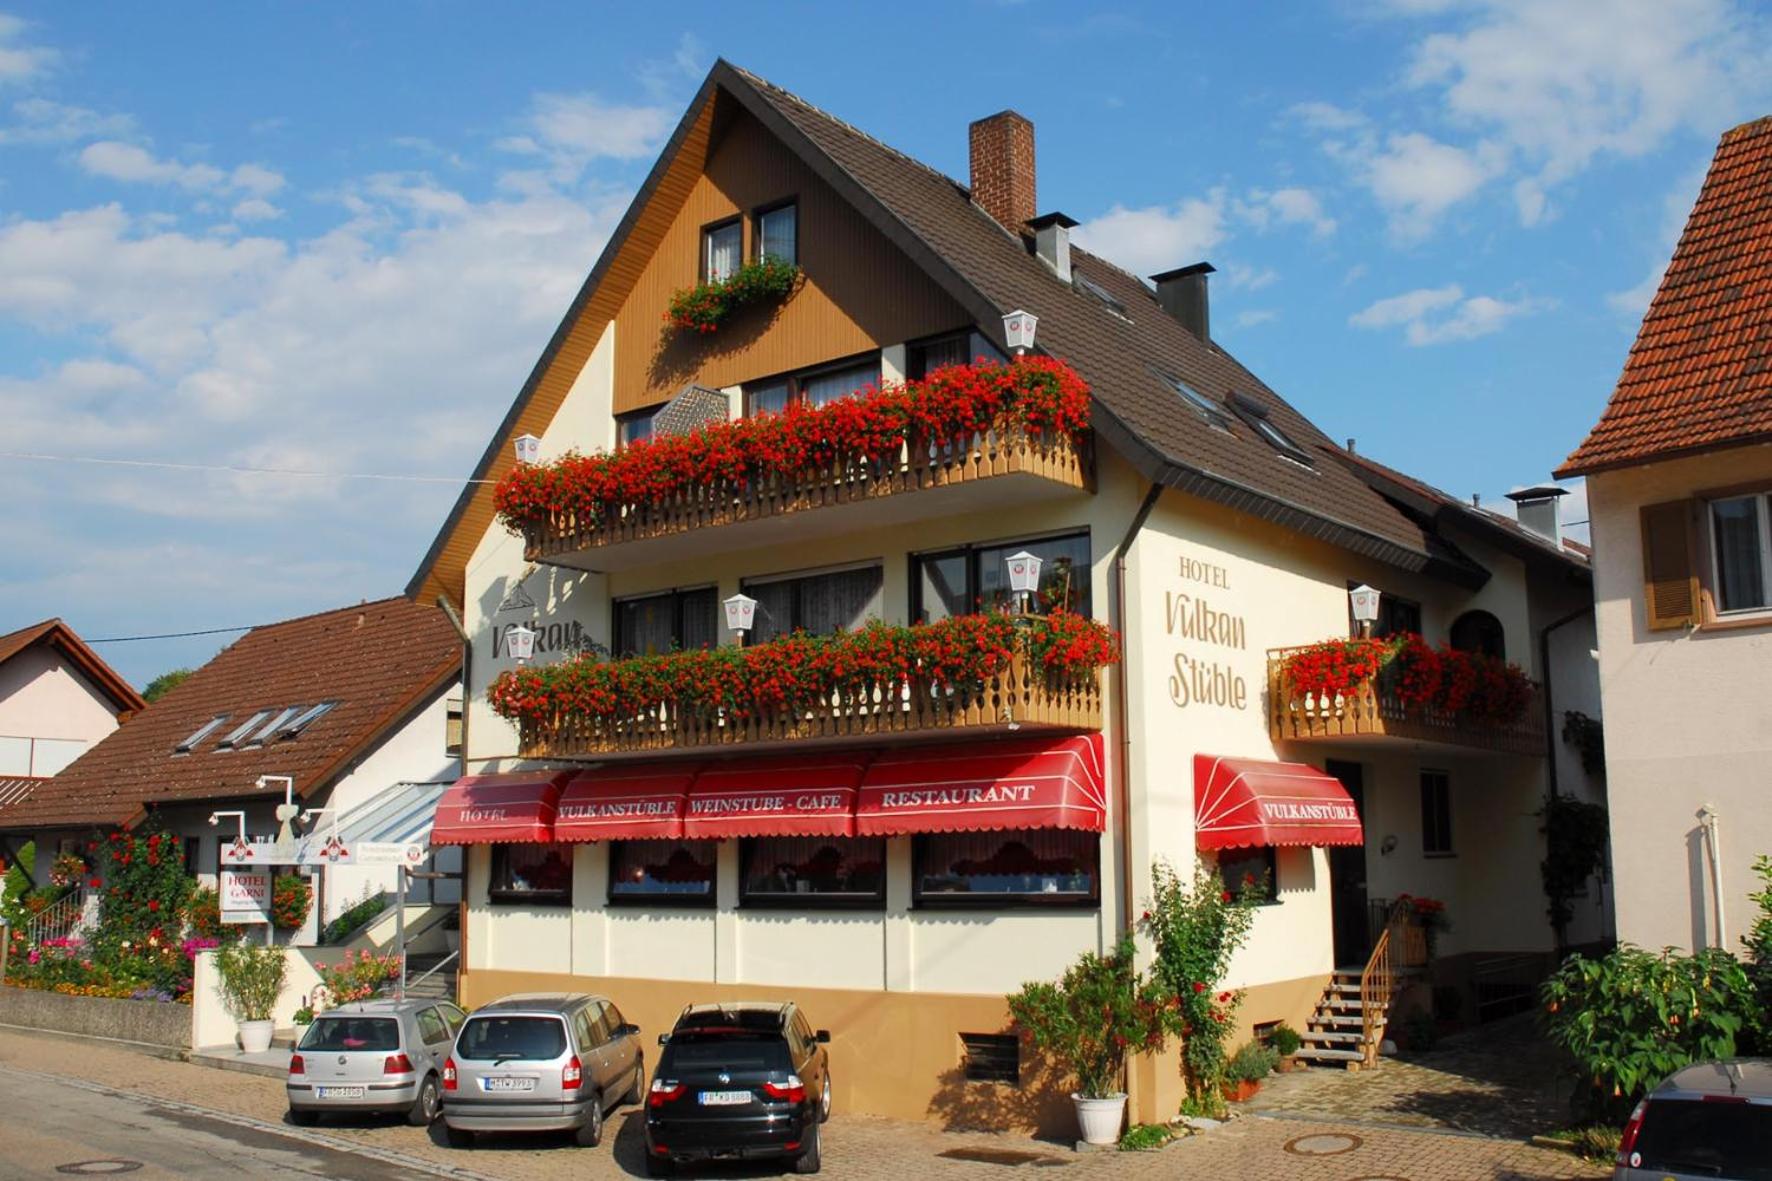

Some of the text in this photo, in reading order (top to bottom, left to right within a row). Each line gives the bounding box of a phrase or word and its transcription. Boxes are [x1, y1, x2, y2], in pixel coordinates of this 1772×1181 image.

[1179, 556, 1231, 590] HOTEL
[1165, 591, 1246, 650] Vulkan
[1169, 653, 1247, 710] Stüble
[691, 797, 784, 813] WEINSTUBE
[796, 795, 841, 810] CAFE
[882, 785, 1035, 807] RESTAURANT
[460, 809, 508, 822] HOTEL
[560, 800, 676, 818] VULKANSTÜBLE
[1264, 803, 1357, 820] VULKANSTÜBLE
[228, 876, 265, 886] HOTEL
[231, 888, 264, 898] GARNI
